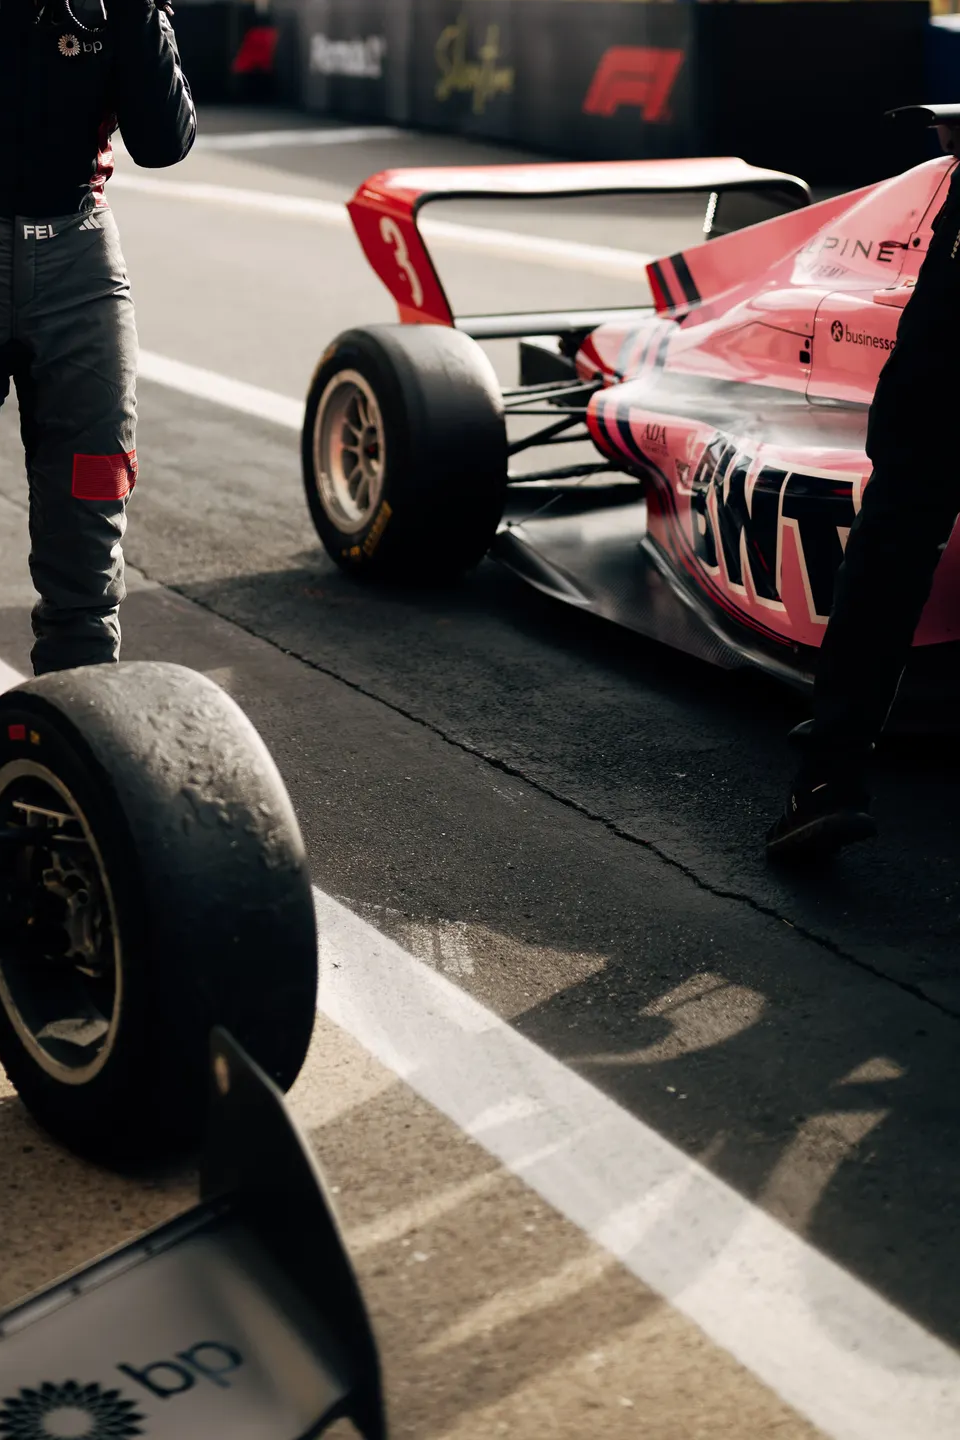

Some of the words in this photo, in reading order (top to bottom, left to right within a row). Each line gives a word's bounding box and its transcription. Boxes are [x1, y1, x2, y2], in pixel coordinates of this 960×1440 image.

[83, 41, 103, 54] bp
[379, 216, 424, 308] 3
[116, 1340, 244, 1399] bp
